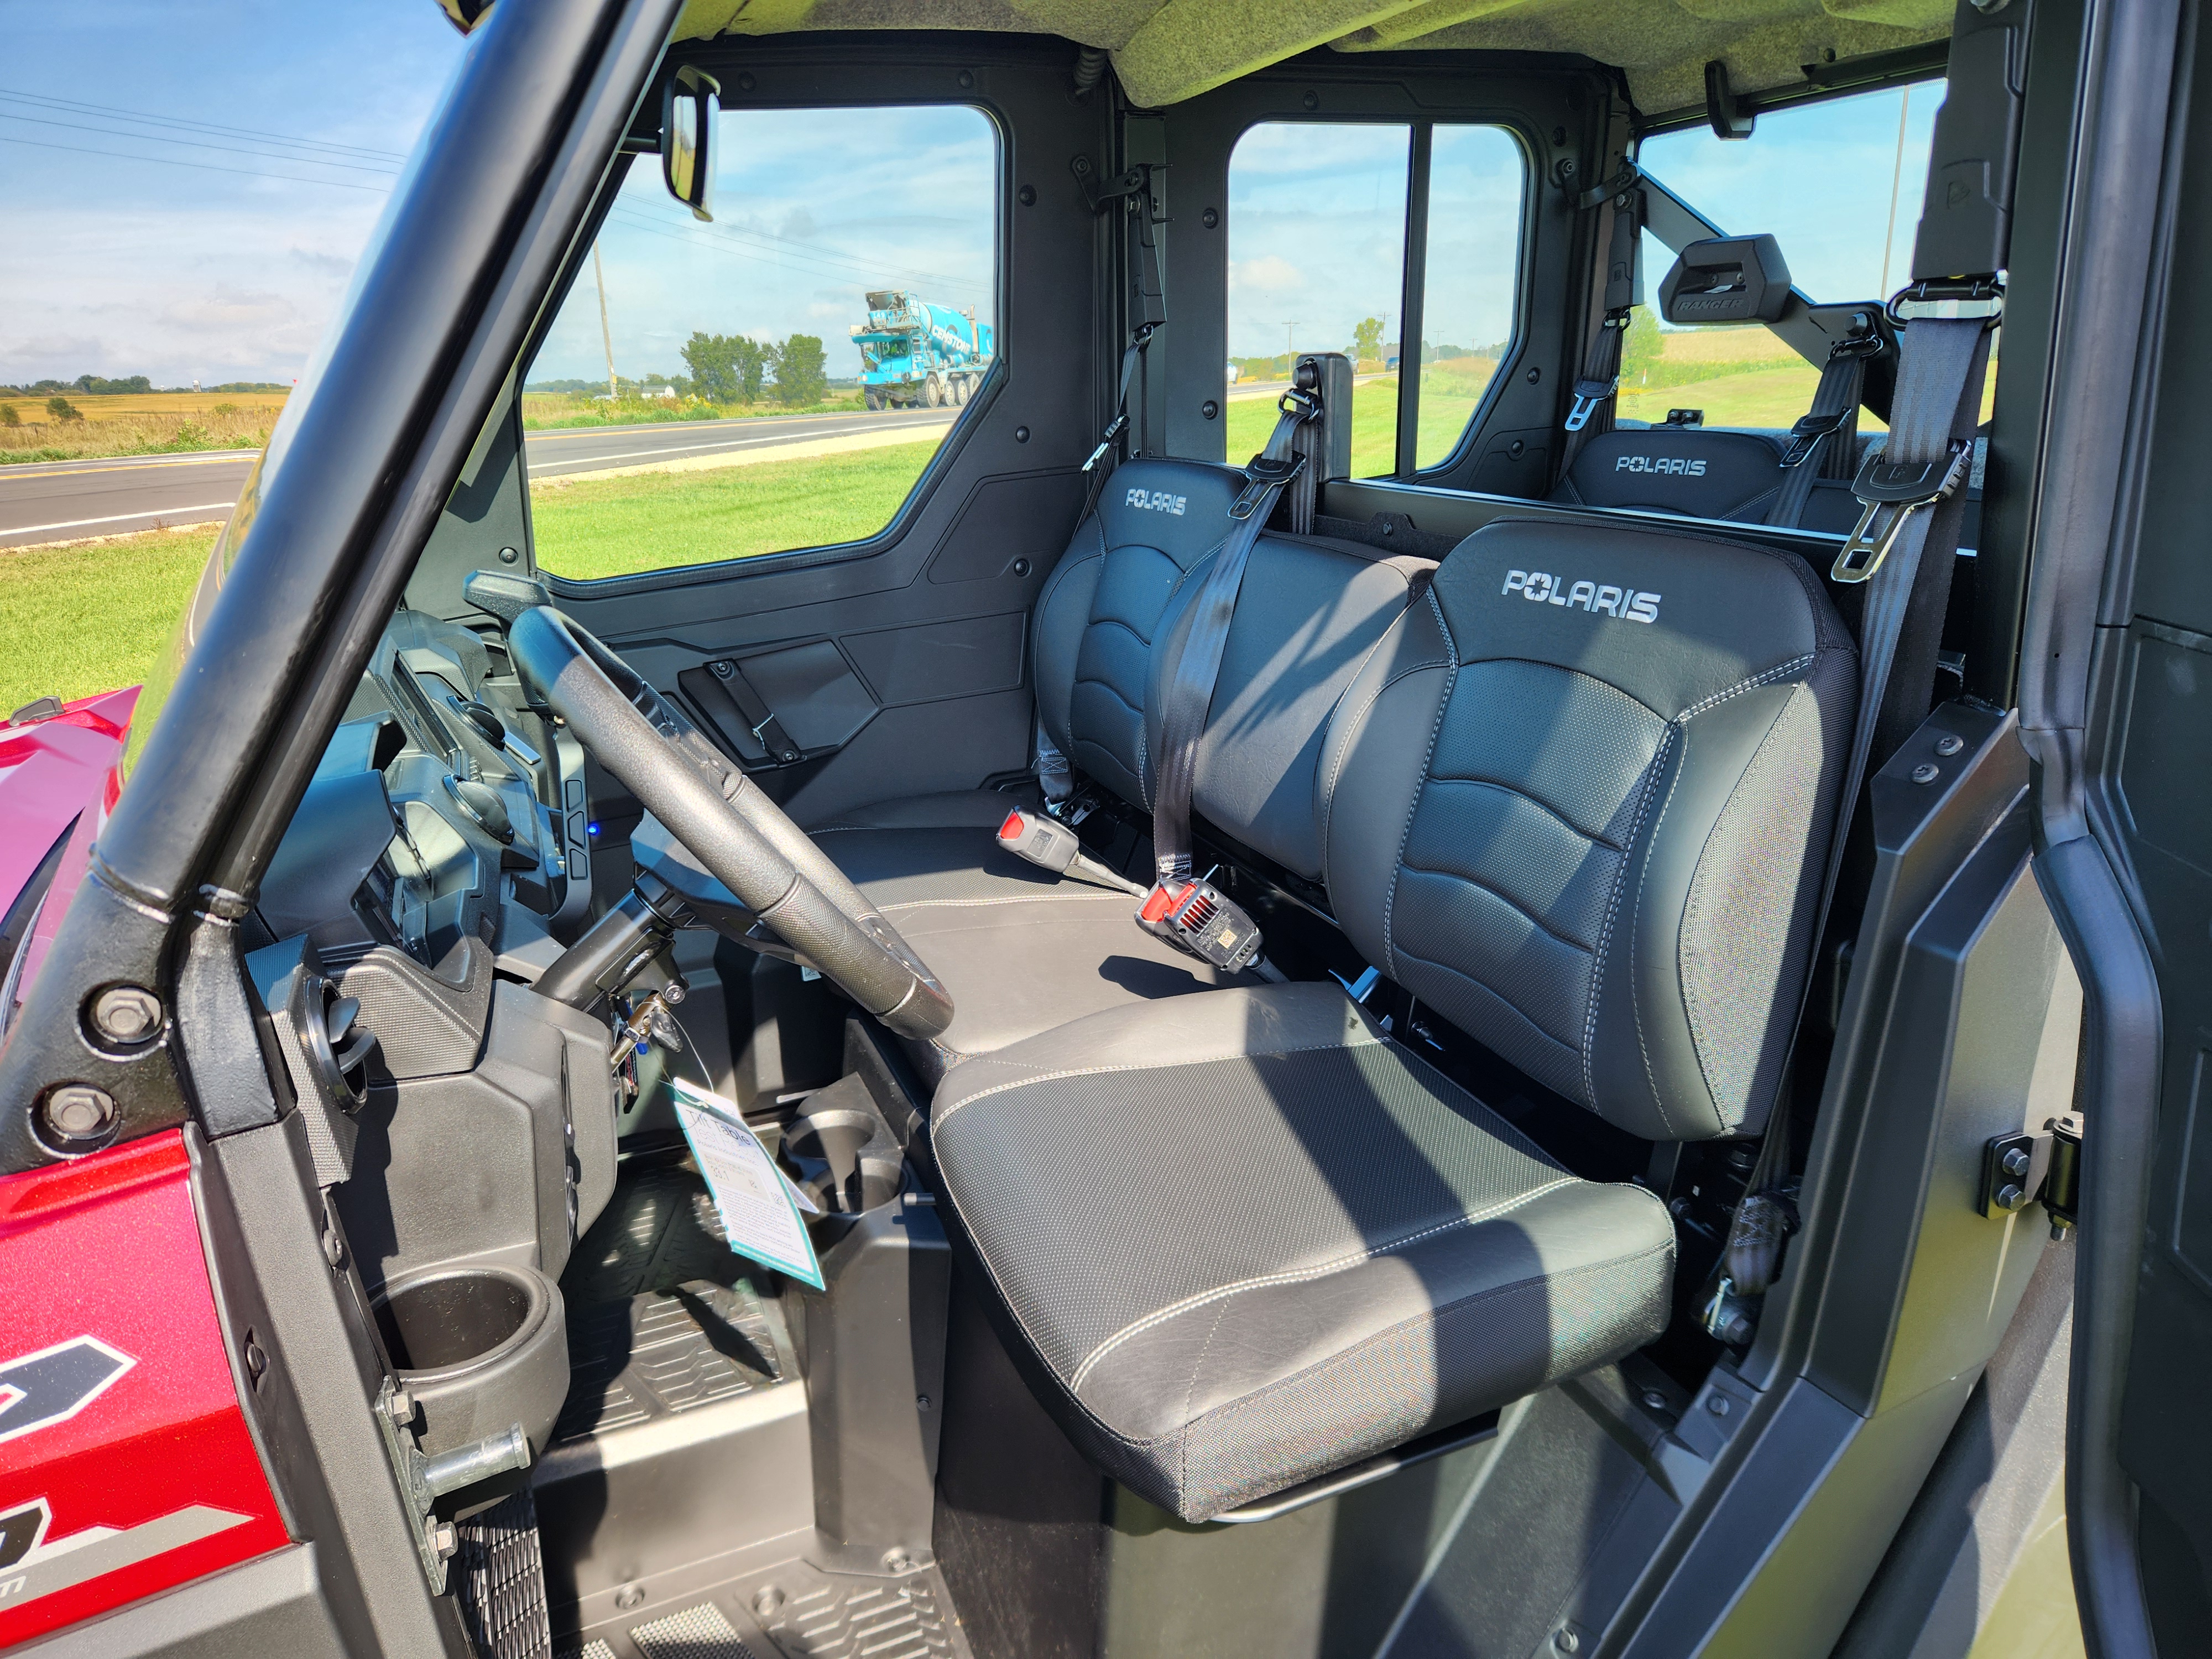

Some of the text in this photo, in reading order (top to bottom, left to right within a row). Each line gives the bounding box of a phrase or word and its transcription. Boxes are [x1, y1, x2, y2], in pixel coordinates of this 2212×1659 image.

[1677, 299, 1745, 310] RANGER
[932, 325, 972, 356] CEMSTONE
[1615, 456, 1707, 476] POLARIS
[1125, 488, 1187, 515] POLARIS
[1501, 569, 1661, 624] POLARIS
[686, 1109, 751, 1146] Tilt Table
